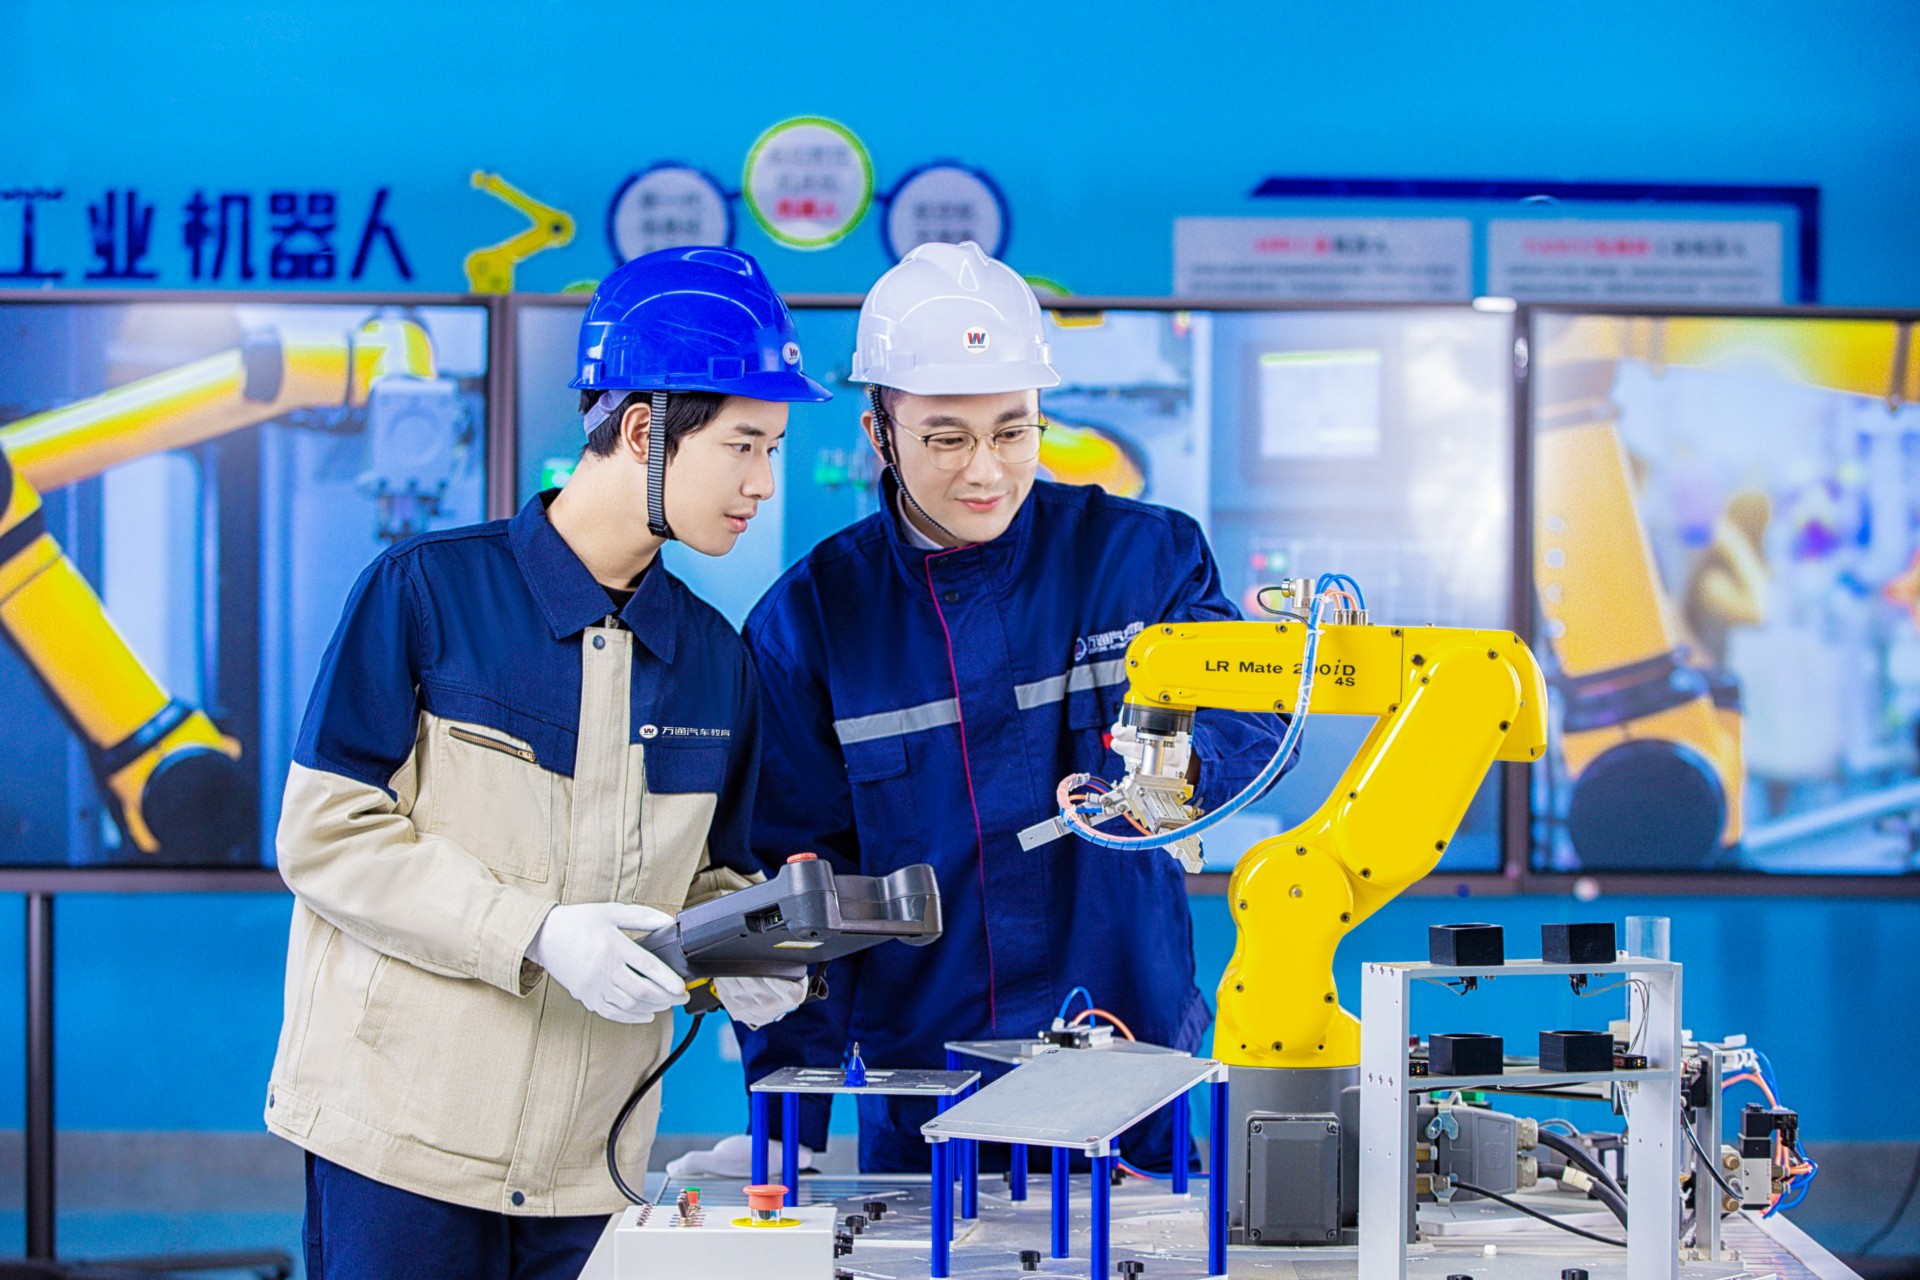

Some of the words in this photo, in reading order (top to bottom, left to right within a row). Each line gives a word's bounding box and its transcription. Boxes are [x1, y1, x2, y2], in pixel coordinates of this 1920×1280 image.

[0, 188, 413, 280] 工业机器人
[1205, 660, 1230, 672] LR
[1239, 661, 1284, 674] Mate
[1293, 659, 1356, 676] 20iD
[1334, 677, 1355, 687] 4S
[662, 726, 730, 736] 万通汽车教育
